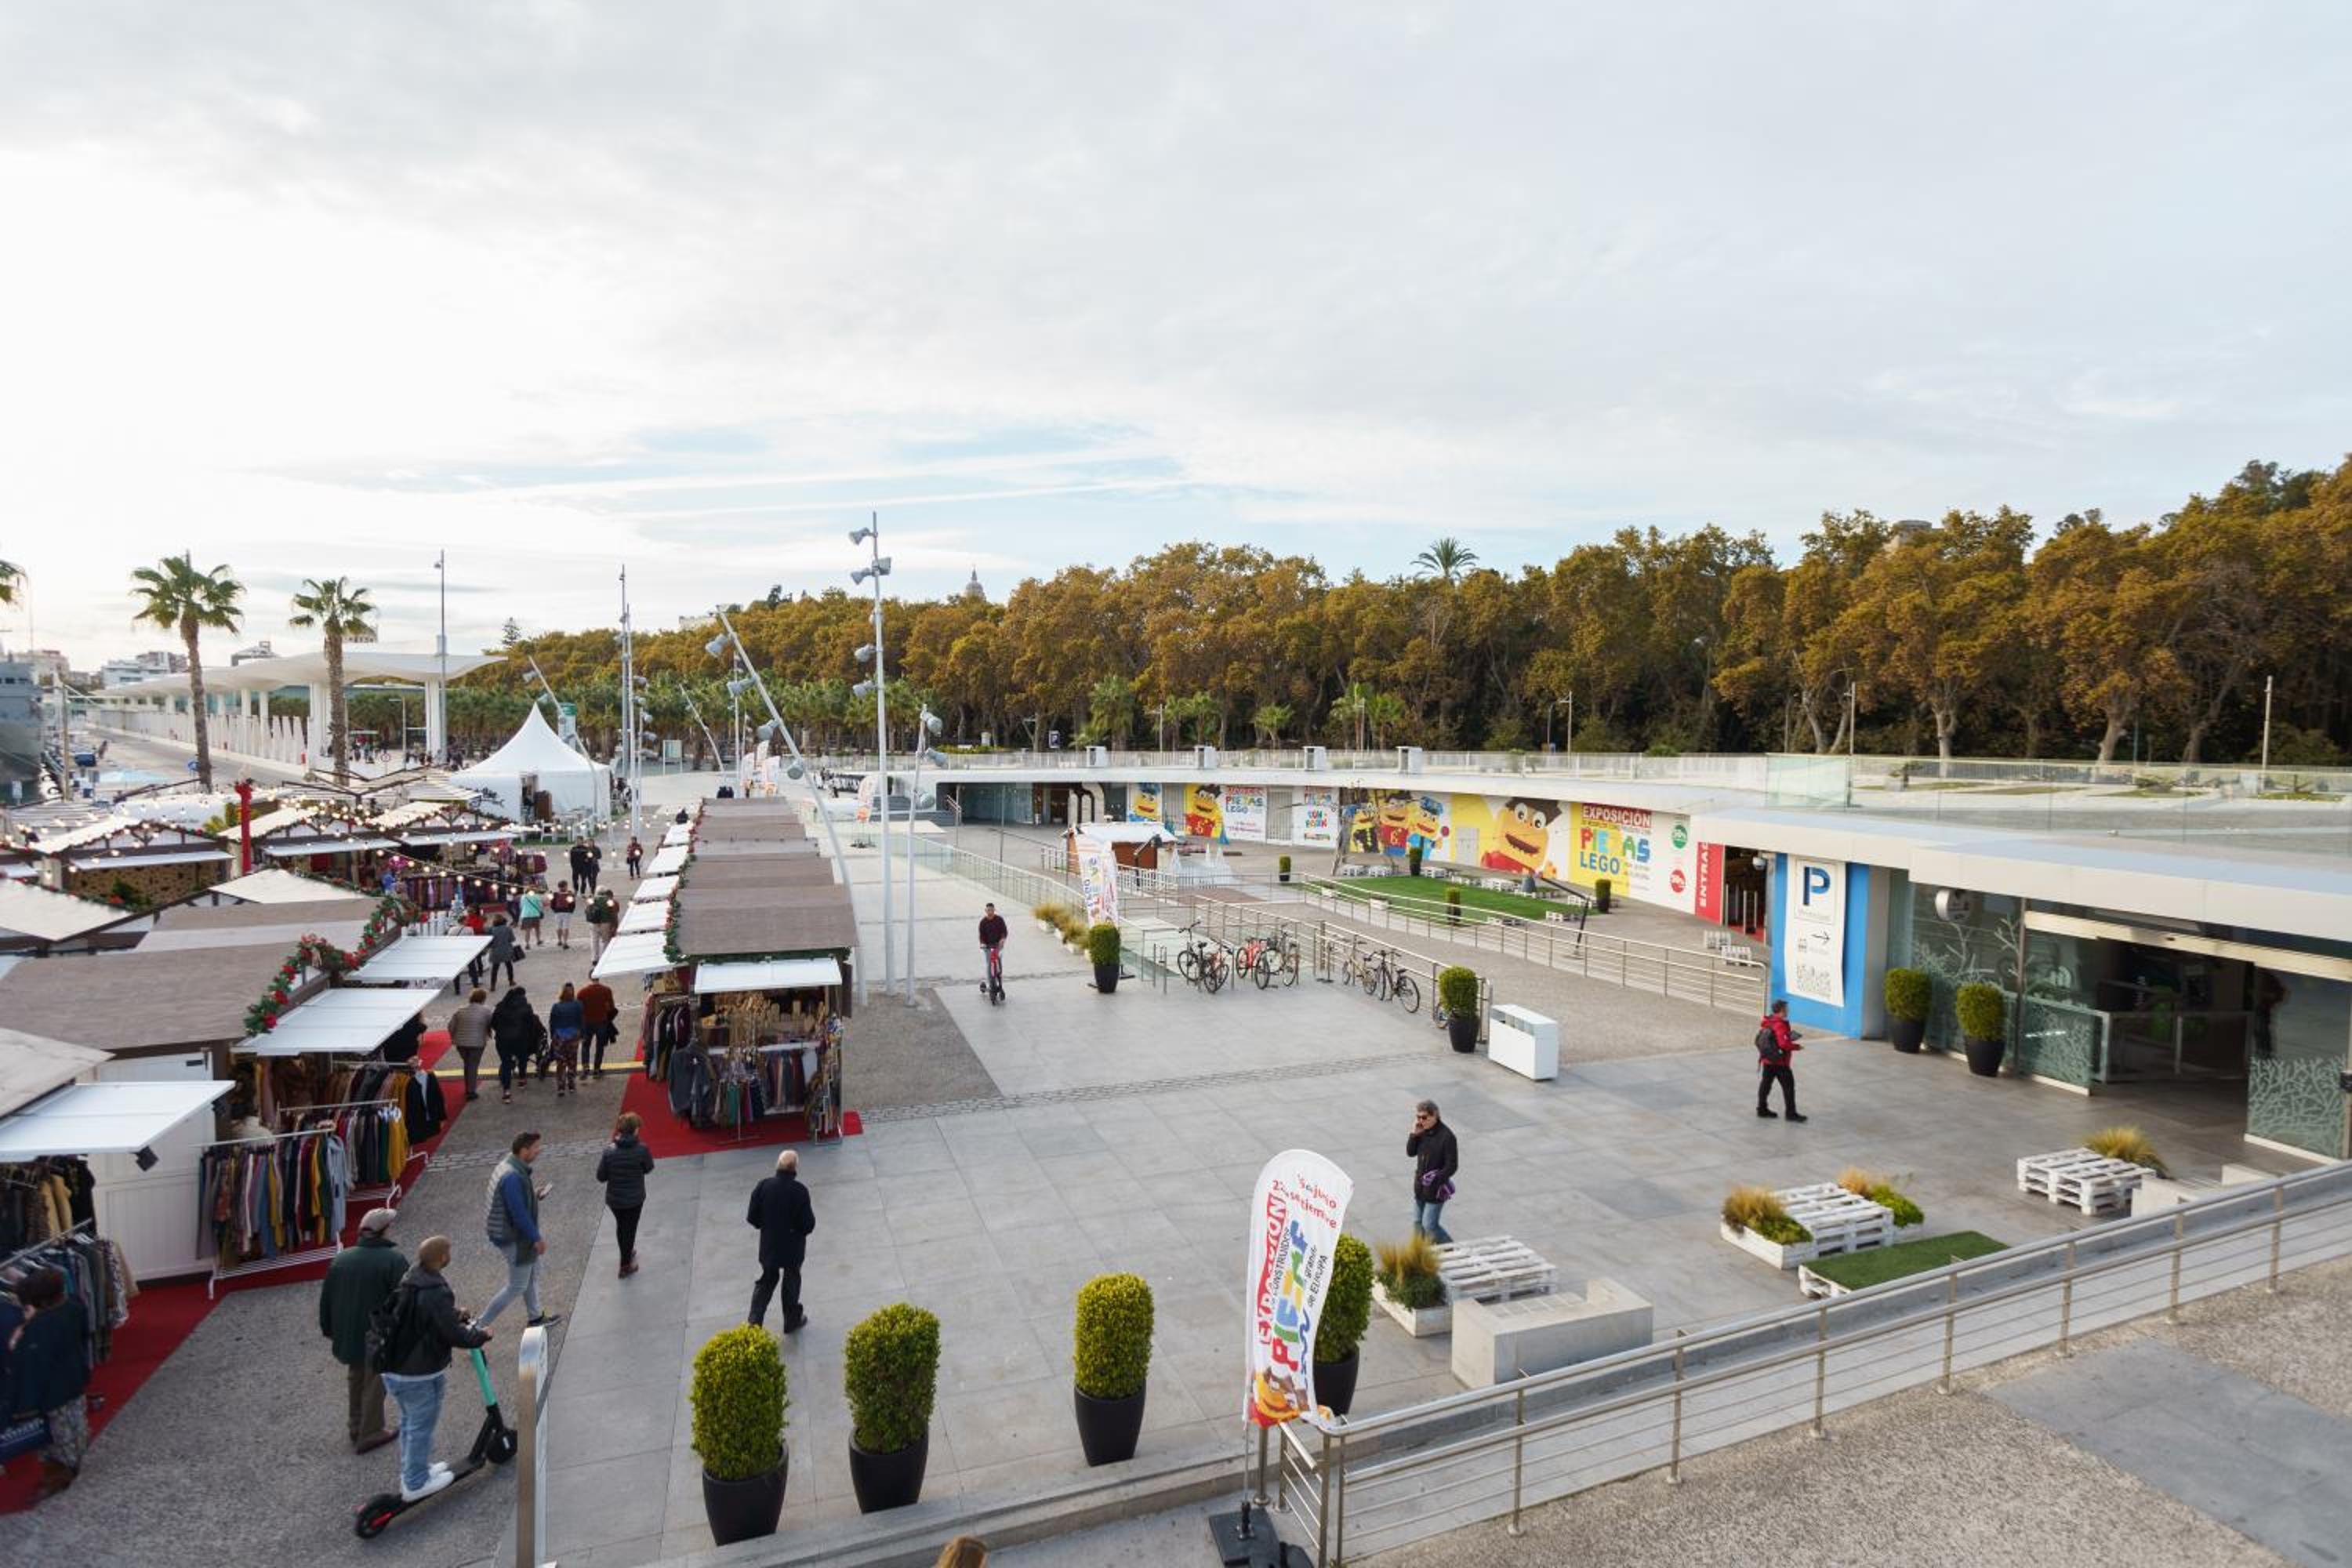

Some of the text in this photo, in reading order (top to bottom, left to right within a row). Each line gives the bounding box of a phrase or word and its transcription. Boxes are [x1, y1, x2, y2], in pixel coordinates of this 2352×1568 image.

[1580, 827, 1650, 863] PIEAS
[1580, 851, 1621, 875] LEGO
[1802, 866, 1831, 906] P
